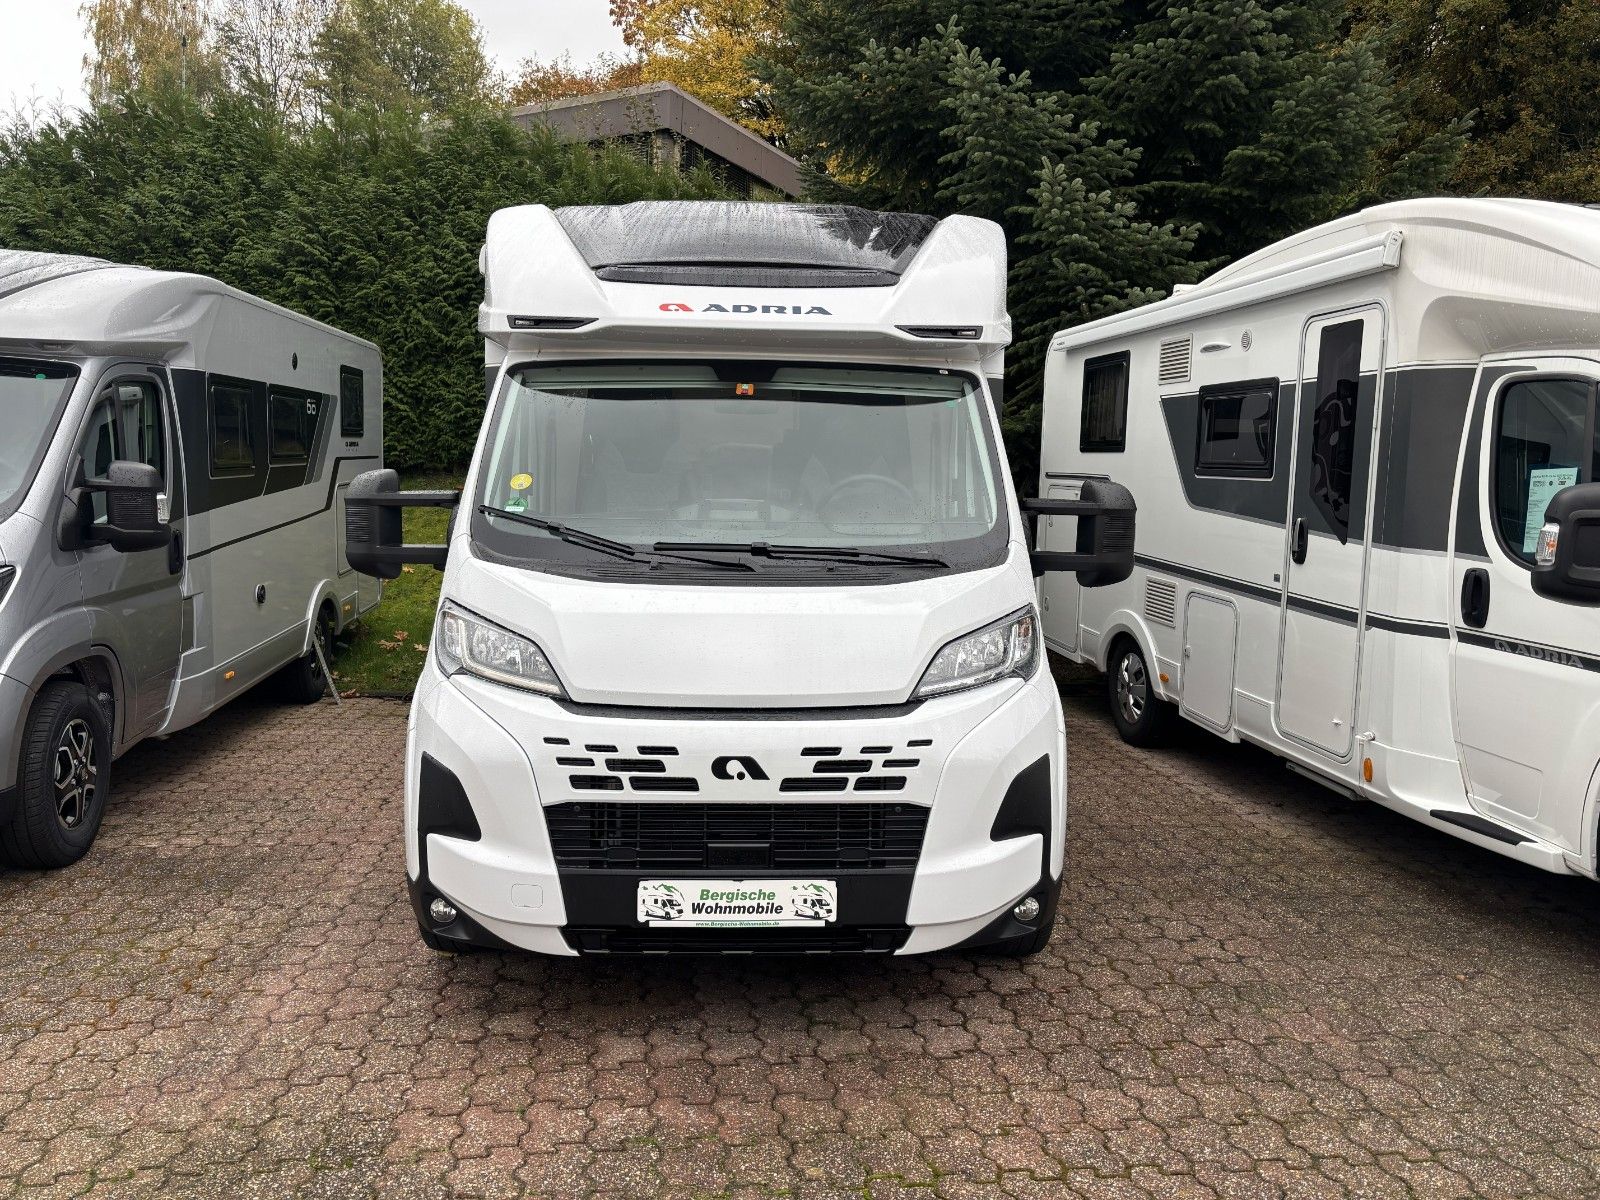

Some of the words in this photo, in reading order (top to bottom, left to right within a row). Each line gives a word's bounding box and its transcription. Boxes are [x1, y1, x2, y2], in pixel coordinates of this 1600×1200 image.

[702, 303, 833, 315] ADRIA
[1516, 643, 1584, 669] ADRIA
[699, 889, 775, 903] Bergische
[691, 902, 784, 914] Wohnmobile
